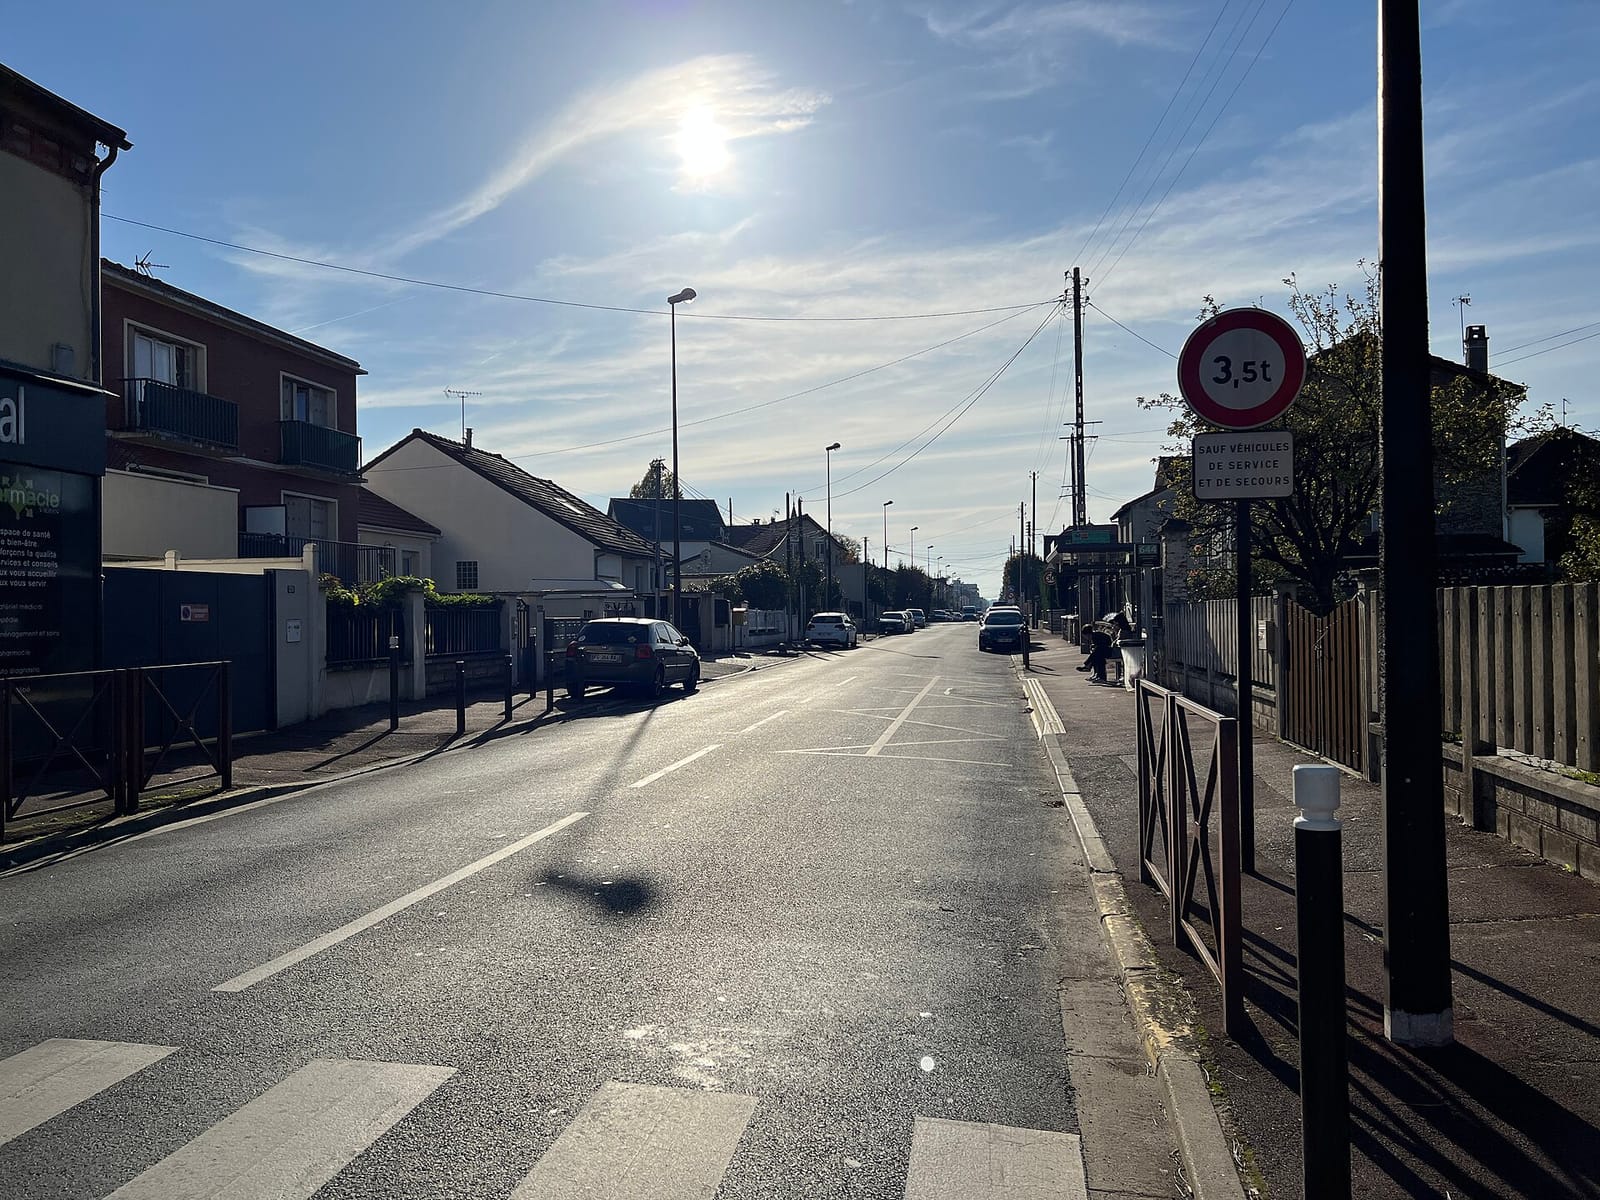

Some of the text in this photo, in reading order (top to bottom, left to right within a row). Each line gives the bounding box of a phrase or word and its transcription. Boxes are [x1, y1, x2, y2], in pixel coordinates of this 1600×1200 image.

[1212, 355, 1272, 389] 3,5t
[0, 386, 25, 445] al
[1198, 442, 1289, 455] SAUF VÉHICULES
[1208, 459, 1279, 471] DE SERVICE
[1198, 476, 1290, 487] ET DE SECOURS
[33, 530, 51, 538] santé
